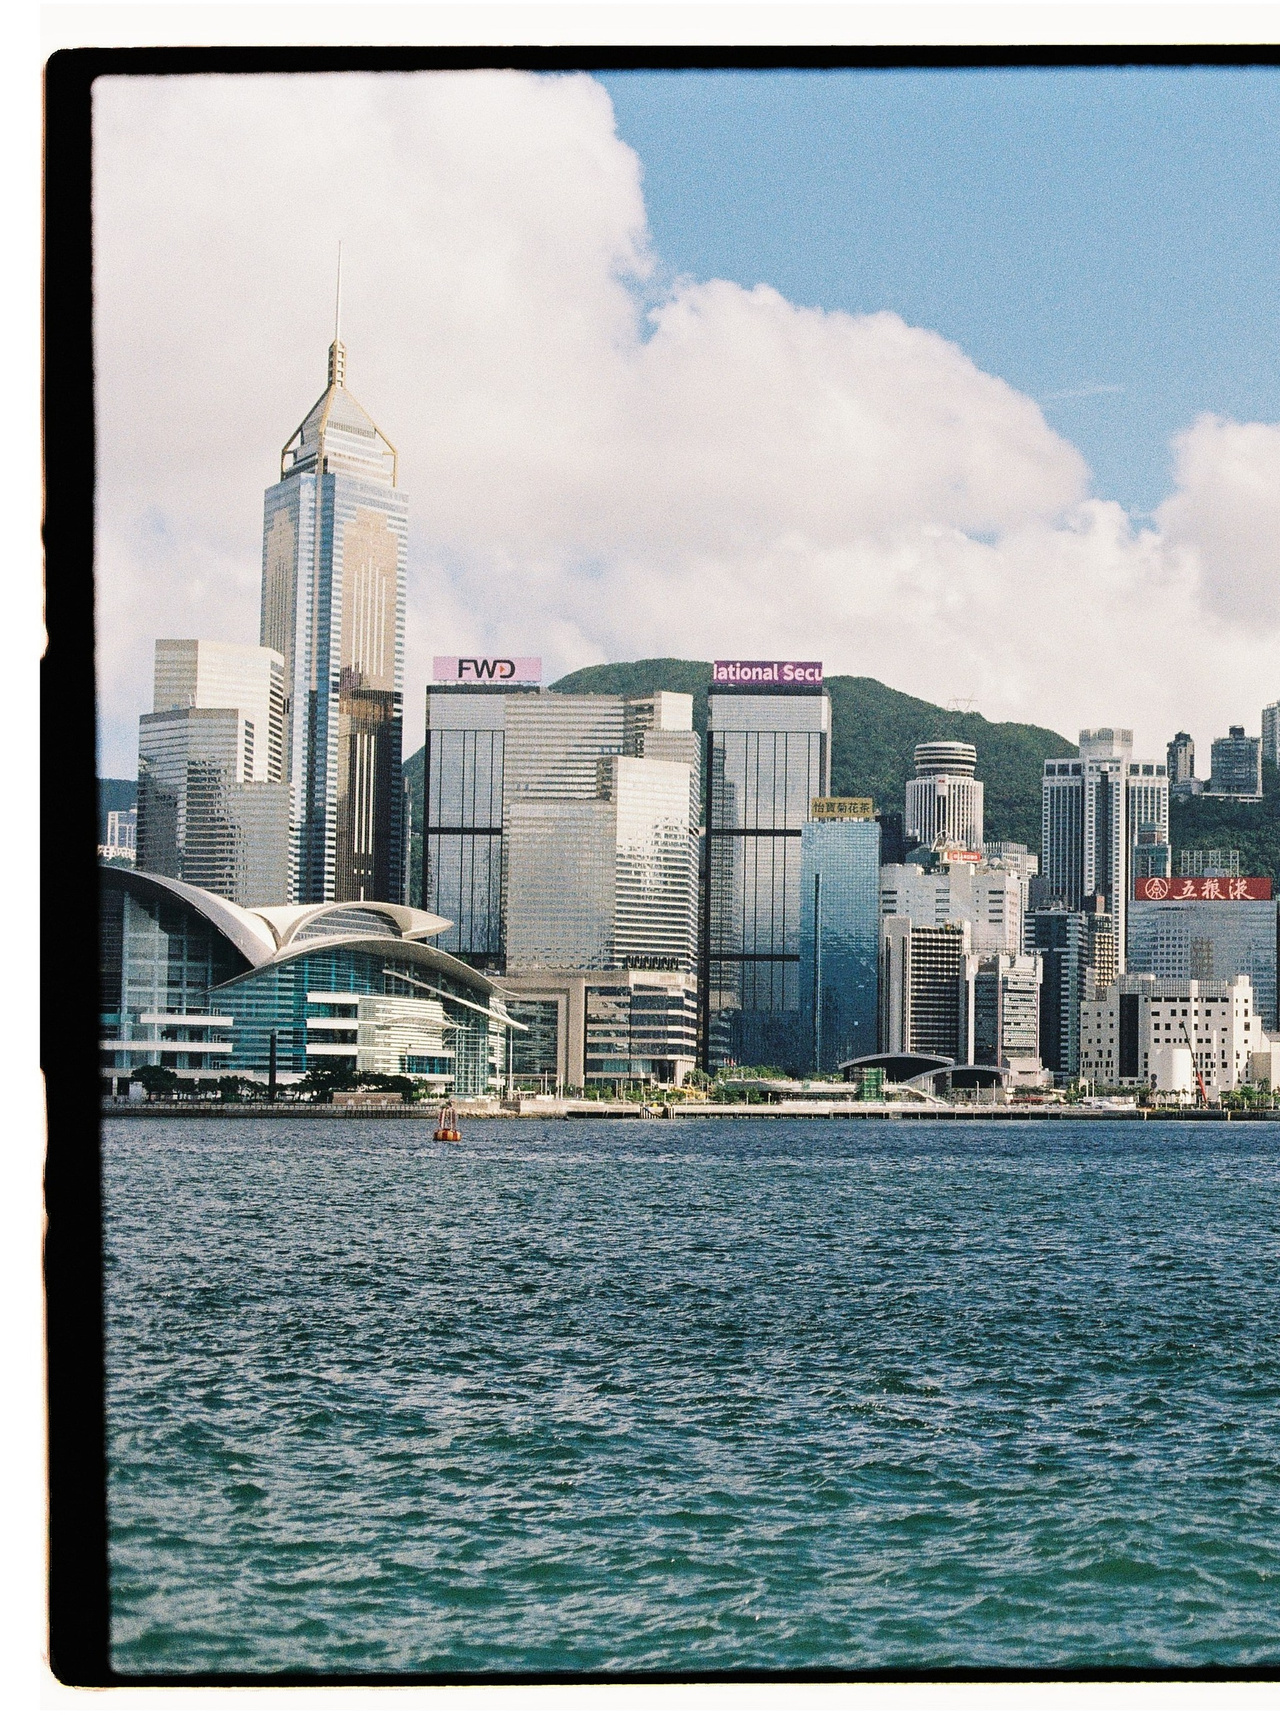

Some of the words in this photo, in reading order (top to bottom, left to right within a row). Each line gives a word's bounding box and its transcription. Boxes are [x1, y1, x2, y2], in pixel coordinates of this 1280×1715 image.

[458, 659, 515, 678] FWD
[714, 662, 778, 680] ational
[783, 664, 823, 680] Secu
